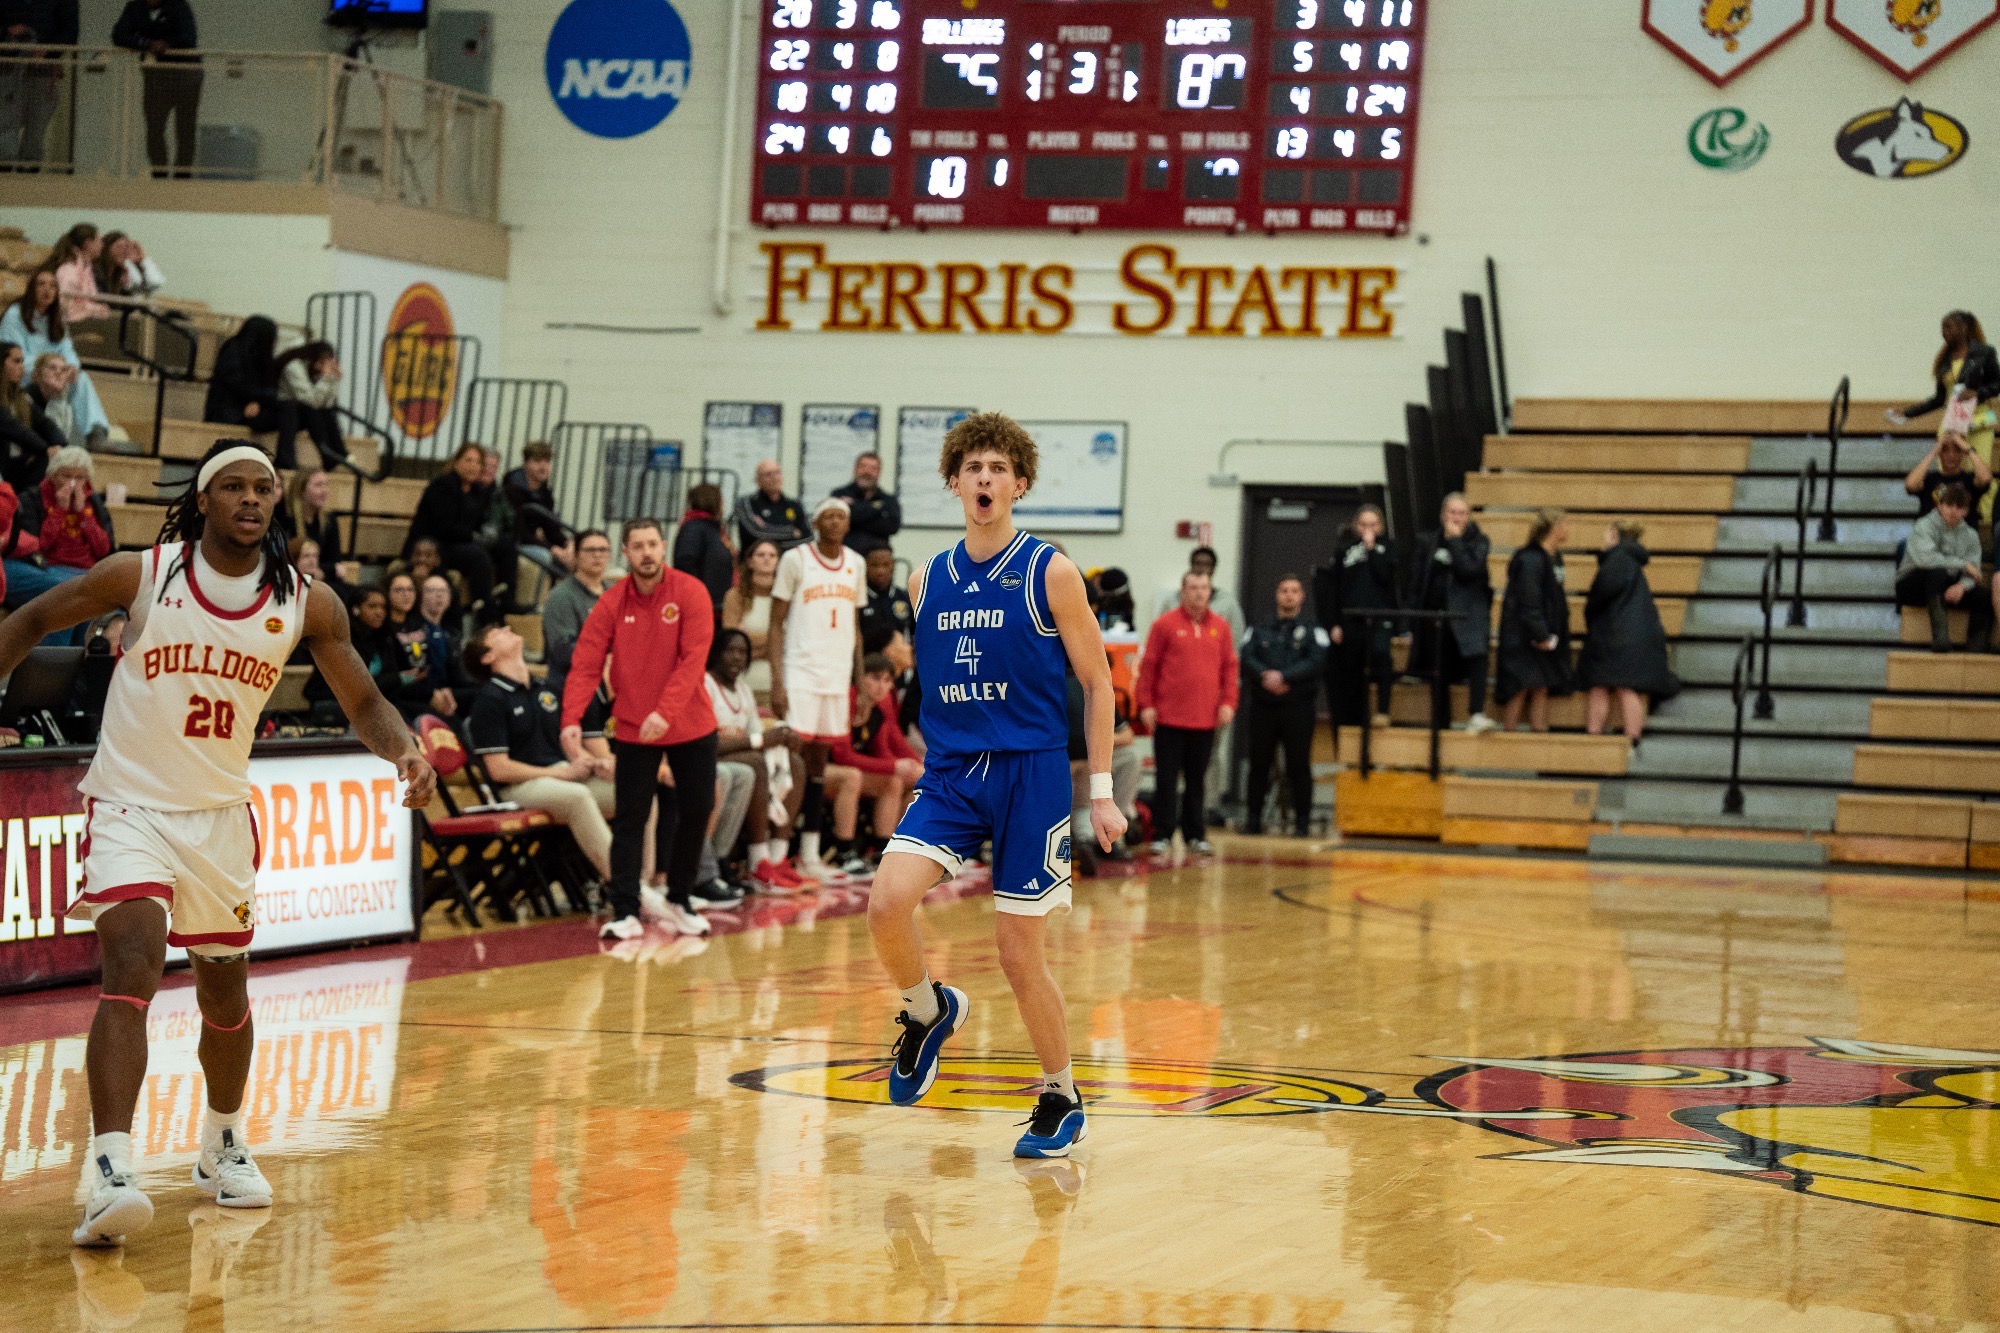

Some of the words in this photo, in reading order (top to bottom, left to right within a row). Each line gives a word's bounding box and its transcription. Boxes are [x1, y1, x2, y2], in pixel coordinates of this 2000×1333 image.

[1344, 0, 1365, 27] 4
[1381, 0, 1412, 26] 11
[770, 40, 810, 71] 22
[833, 42, 854, 69] 4
[1293, 41, 1313, 72] 5
[1340, 43, 1362, 70] 4
[558, 58, 690, 99] NCAA
[1068, 51, 1097, 94] 3
[832, 84, 852, 111] 4
[1290, 87, 1310, 114] 4
[1346, 86, 1358, 113] 1
[1364, 84, 1406, 116] 24
[765, 123, 805, 155] 24
[828, 126, 850, 153] 4
[871, 127, 892, 156] 6
[1276, 128, 1308, 159] 13
[1333, 130, 1355, 157] 4
[1381, 128, 1401, 159] 5
[928, 156, 967, 198] 10
[994, 158, 1008, 186] 1
[756, 242, 1074, 335] FERRIS
[1112, 243, 1397, 338] STATE
[829, 608, 838, 629] 1
[937, 609, 1004, 631] GRAND
[143, 643, 278, 692] BULLDOGS
[954, 635, 983, 676] 4
[938, 682, 1008, 704] VALLEY
[184, 694, 235, 740] 20
[254, 890, 302, 926] FUEL
[306, 879, 397, 919] COMPANY
